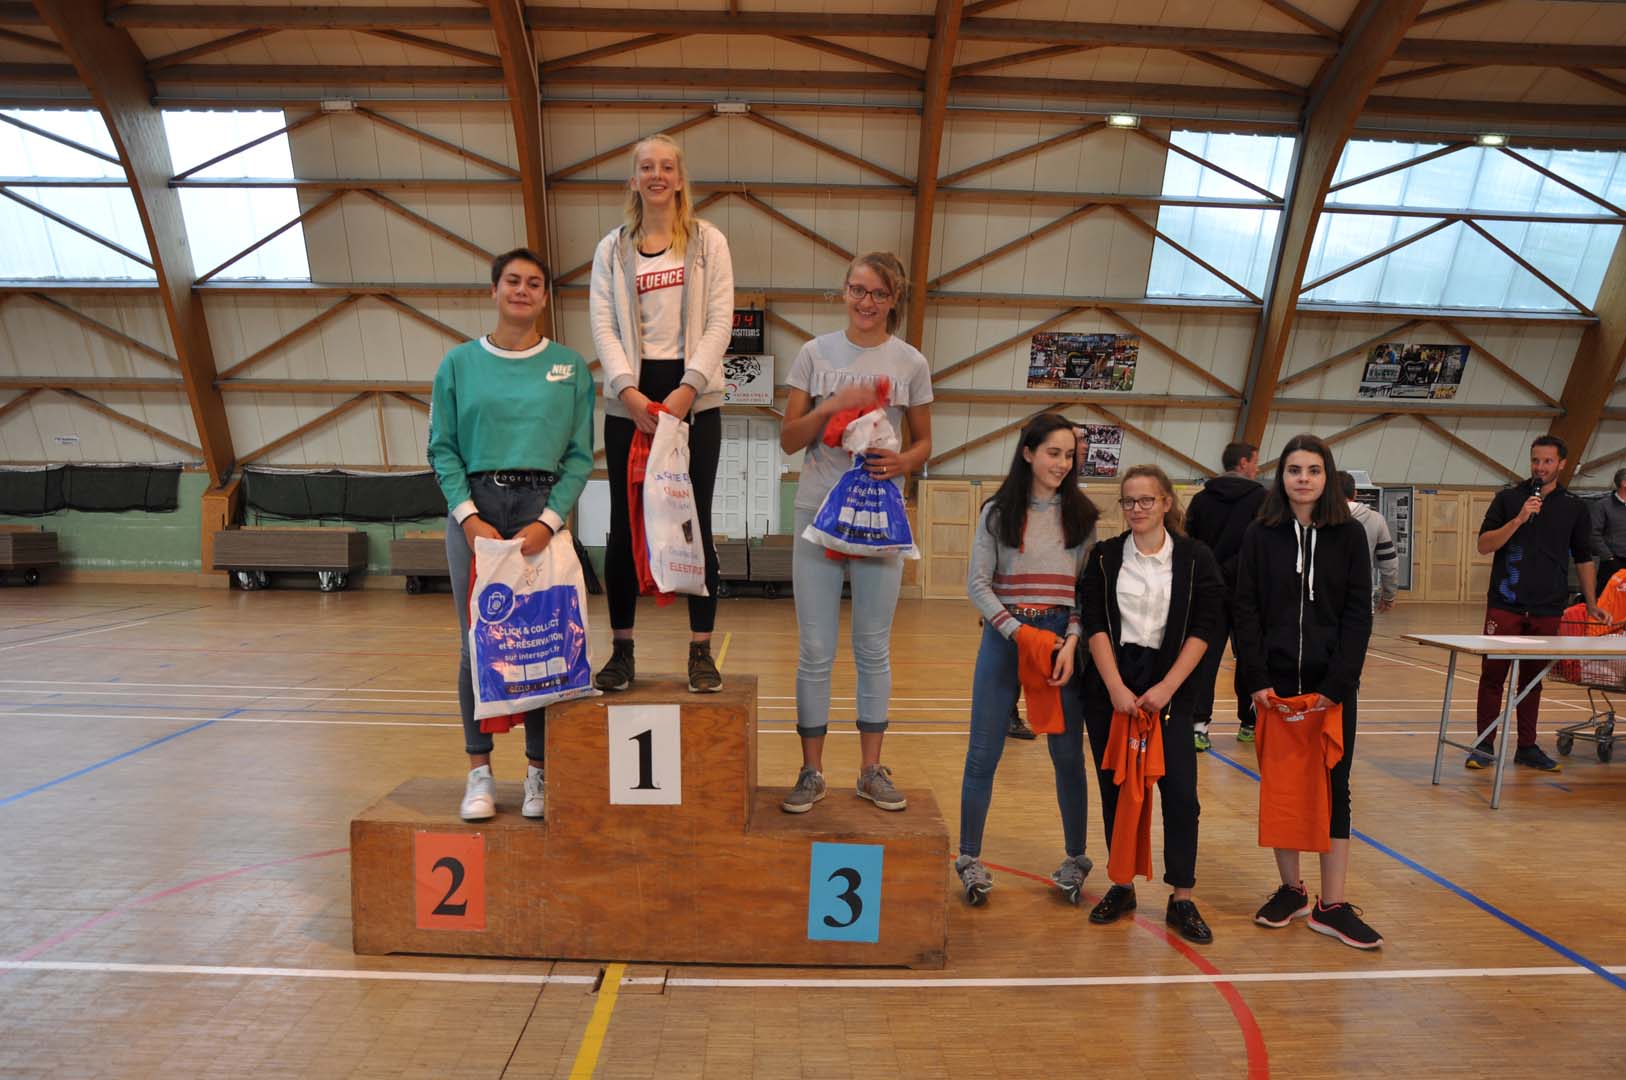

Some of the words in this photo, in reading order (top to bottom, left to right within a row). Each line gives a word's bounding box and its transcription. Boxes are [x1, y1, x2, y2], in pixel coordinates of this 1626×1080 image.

[552, 364, 575, 376] NIKE
[498, 642, 506, 650] et
[500, 626, 522, 637] CLICK
[523, 626, 530, 635] &
[530, 620, 559, 634] COLLECT
[628, 729, 661, 790] 1
[432, 857, 468, 916] 2
[824, 867, 863, 928] 3
